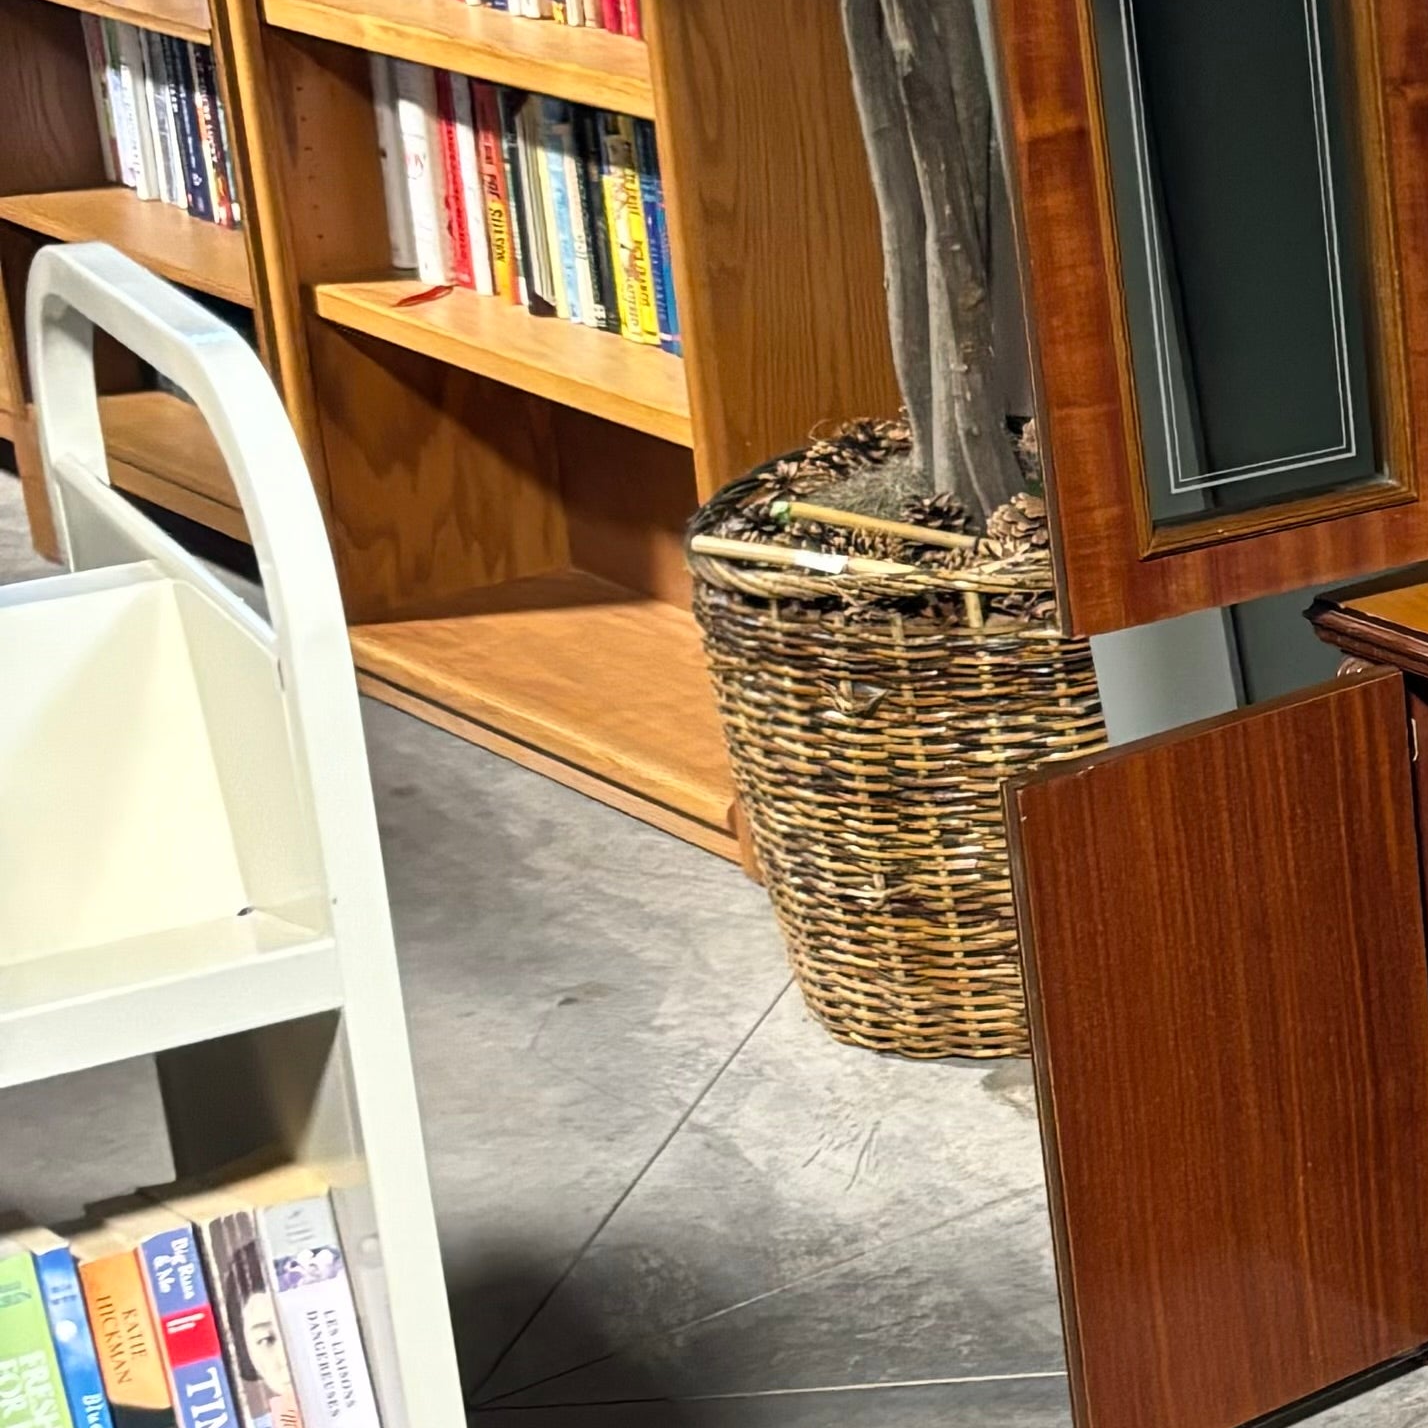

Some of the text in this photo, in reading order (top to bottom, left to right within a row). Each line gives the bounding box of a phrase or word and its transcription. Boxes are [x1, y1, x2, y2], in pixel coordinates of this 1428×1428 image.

[168, 1236, 190, 1266] Big
[96, 1295, 132, 1385] HICKMAN
[122, 1308, 148, 1358] KATIE
[306, 1310, 340, 1418] DANGEREUSES
[322, 1310, 357, 1409] LES LIAISONS
[0, 1357, 28, 1419] FOR
